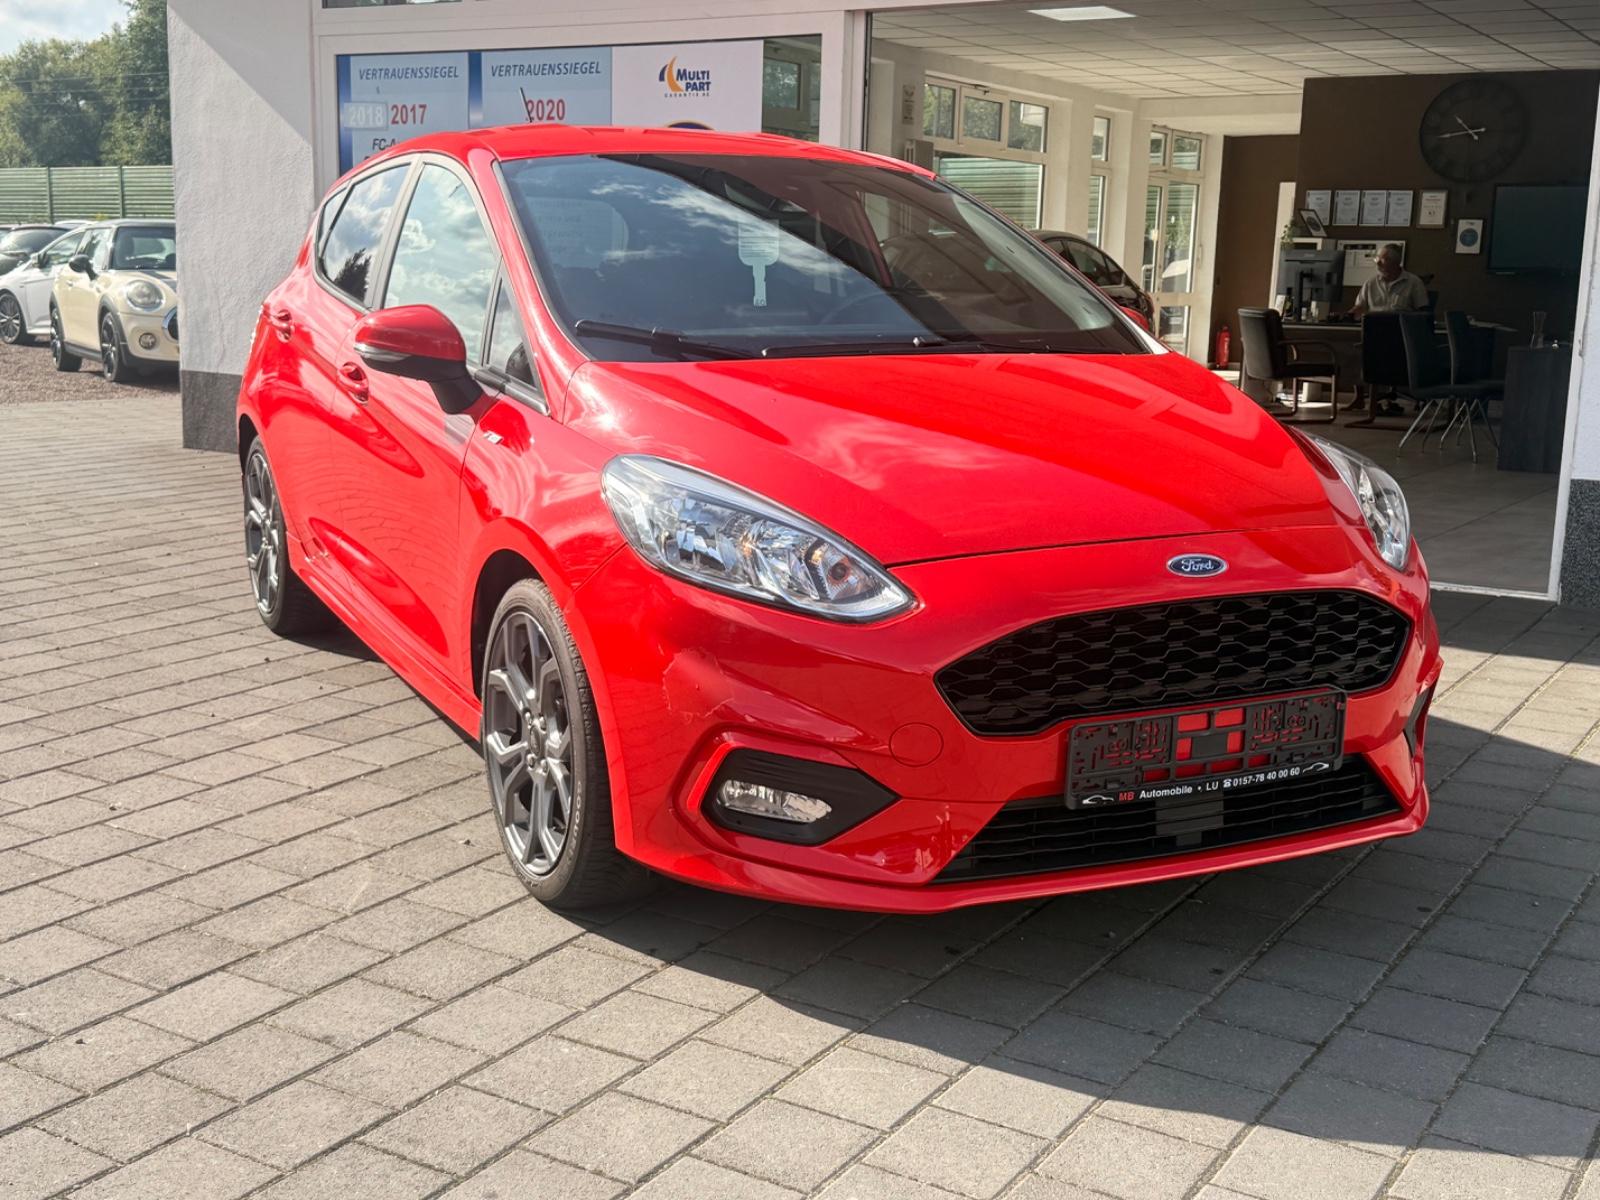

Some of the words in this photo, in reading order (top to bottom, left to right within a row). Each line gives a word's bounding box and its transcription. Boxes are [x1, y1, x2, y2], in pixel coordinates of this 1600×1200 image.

[359, 66, 459, 80] VERTRAUENSSIEGEL
[491, 61, 601, 77] VERTRAUENSSIEGEL
[685, 81, 711, 92] PART
[349, 106, 384, 127] 2018
[390, 104, 427, 125] 2017
[525, 98, 566, 121] 2020
[371, 138, 400, 151] FC-A
[1181, 559, 1214, 572] Ford
[1119, 791, 1135, 801] MB
[1138, 785, 1193, 799] Automobile
[1206, 781, 1219, 791] LU
[1232, 773, 1265, 787] 0157-78
[1266, 771, 1277, 780] 40
[1278, 769, 1289, 779] 00
[1290, 766, 1301, 776] 60
